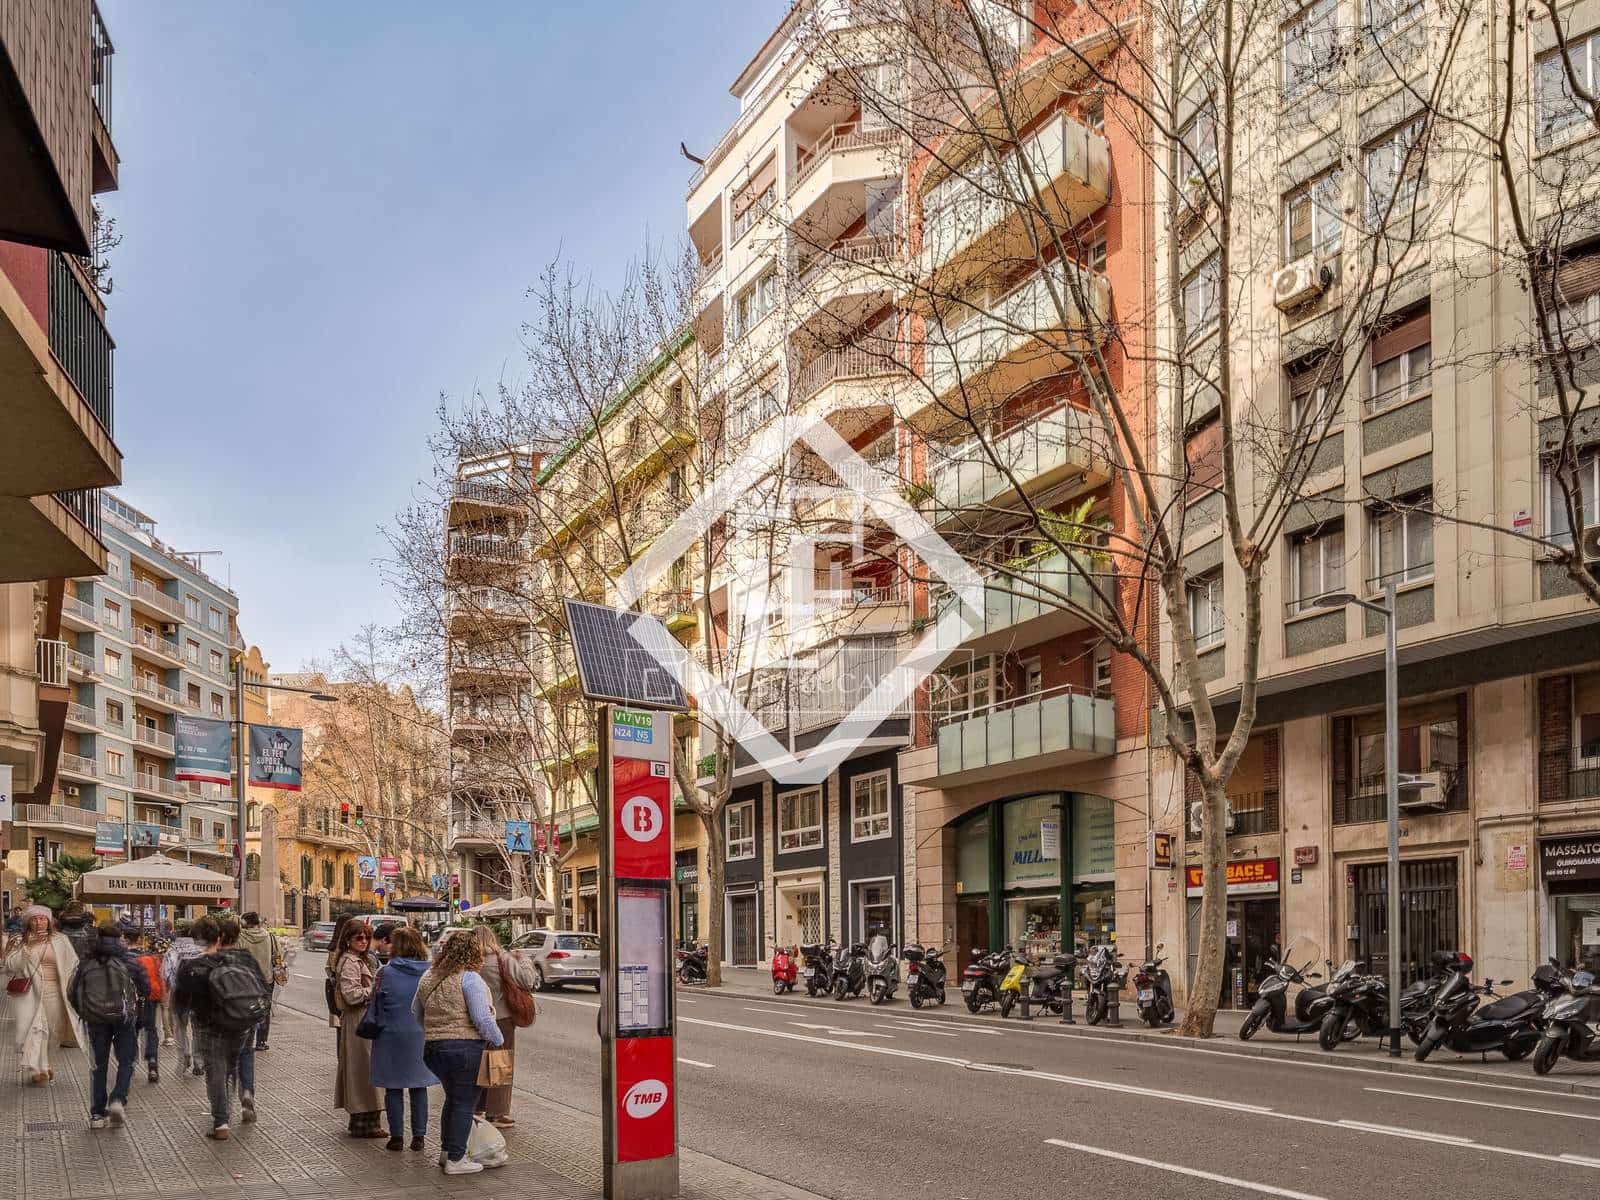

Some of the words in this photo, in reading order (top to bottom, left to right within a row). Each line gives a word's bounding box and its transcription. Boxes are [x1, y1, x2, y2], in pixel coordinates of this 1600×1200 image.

[614, 711, 633, 722] V17
[634, 714, 652, 727] V19
[614, 727, 632, 738] N24
[1226, 863, 1265, 878] BACS
[108, 879, 128, 889] BAR
[136, 880, 189, 892] RESTAURANT
[191, 882, 222, 893] CHICHO
[633, 1092, 662, 1105] TMB
